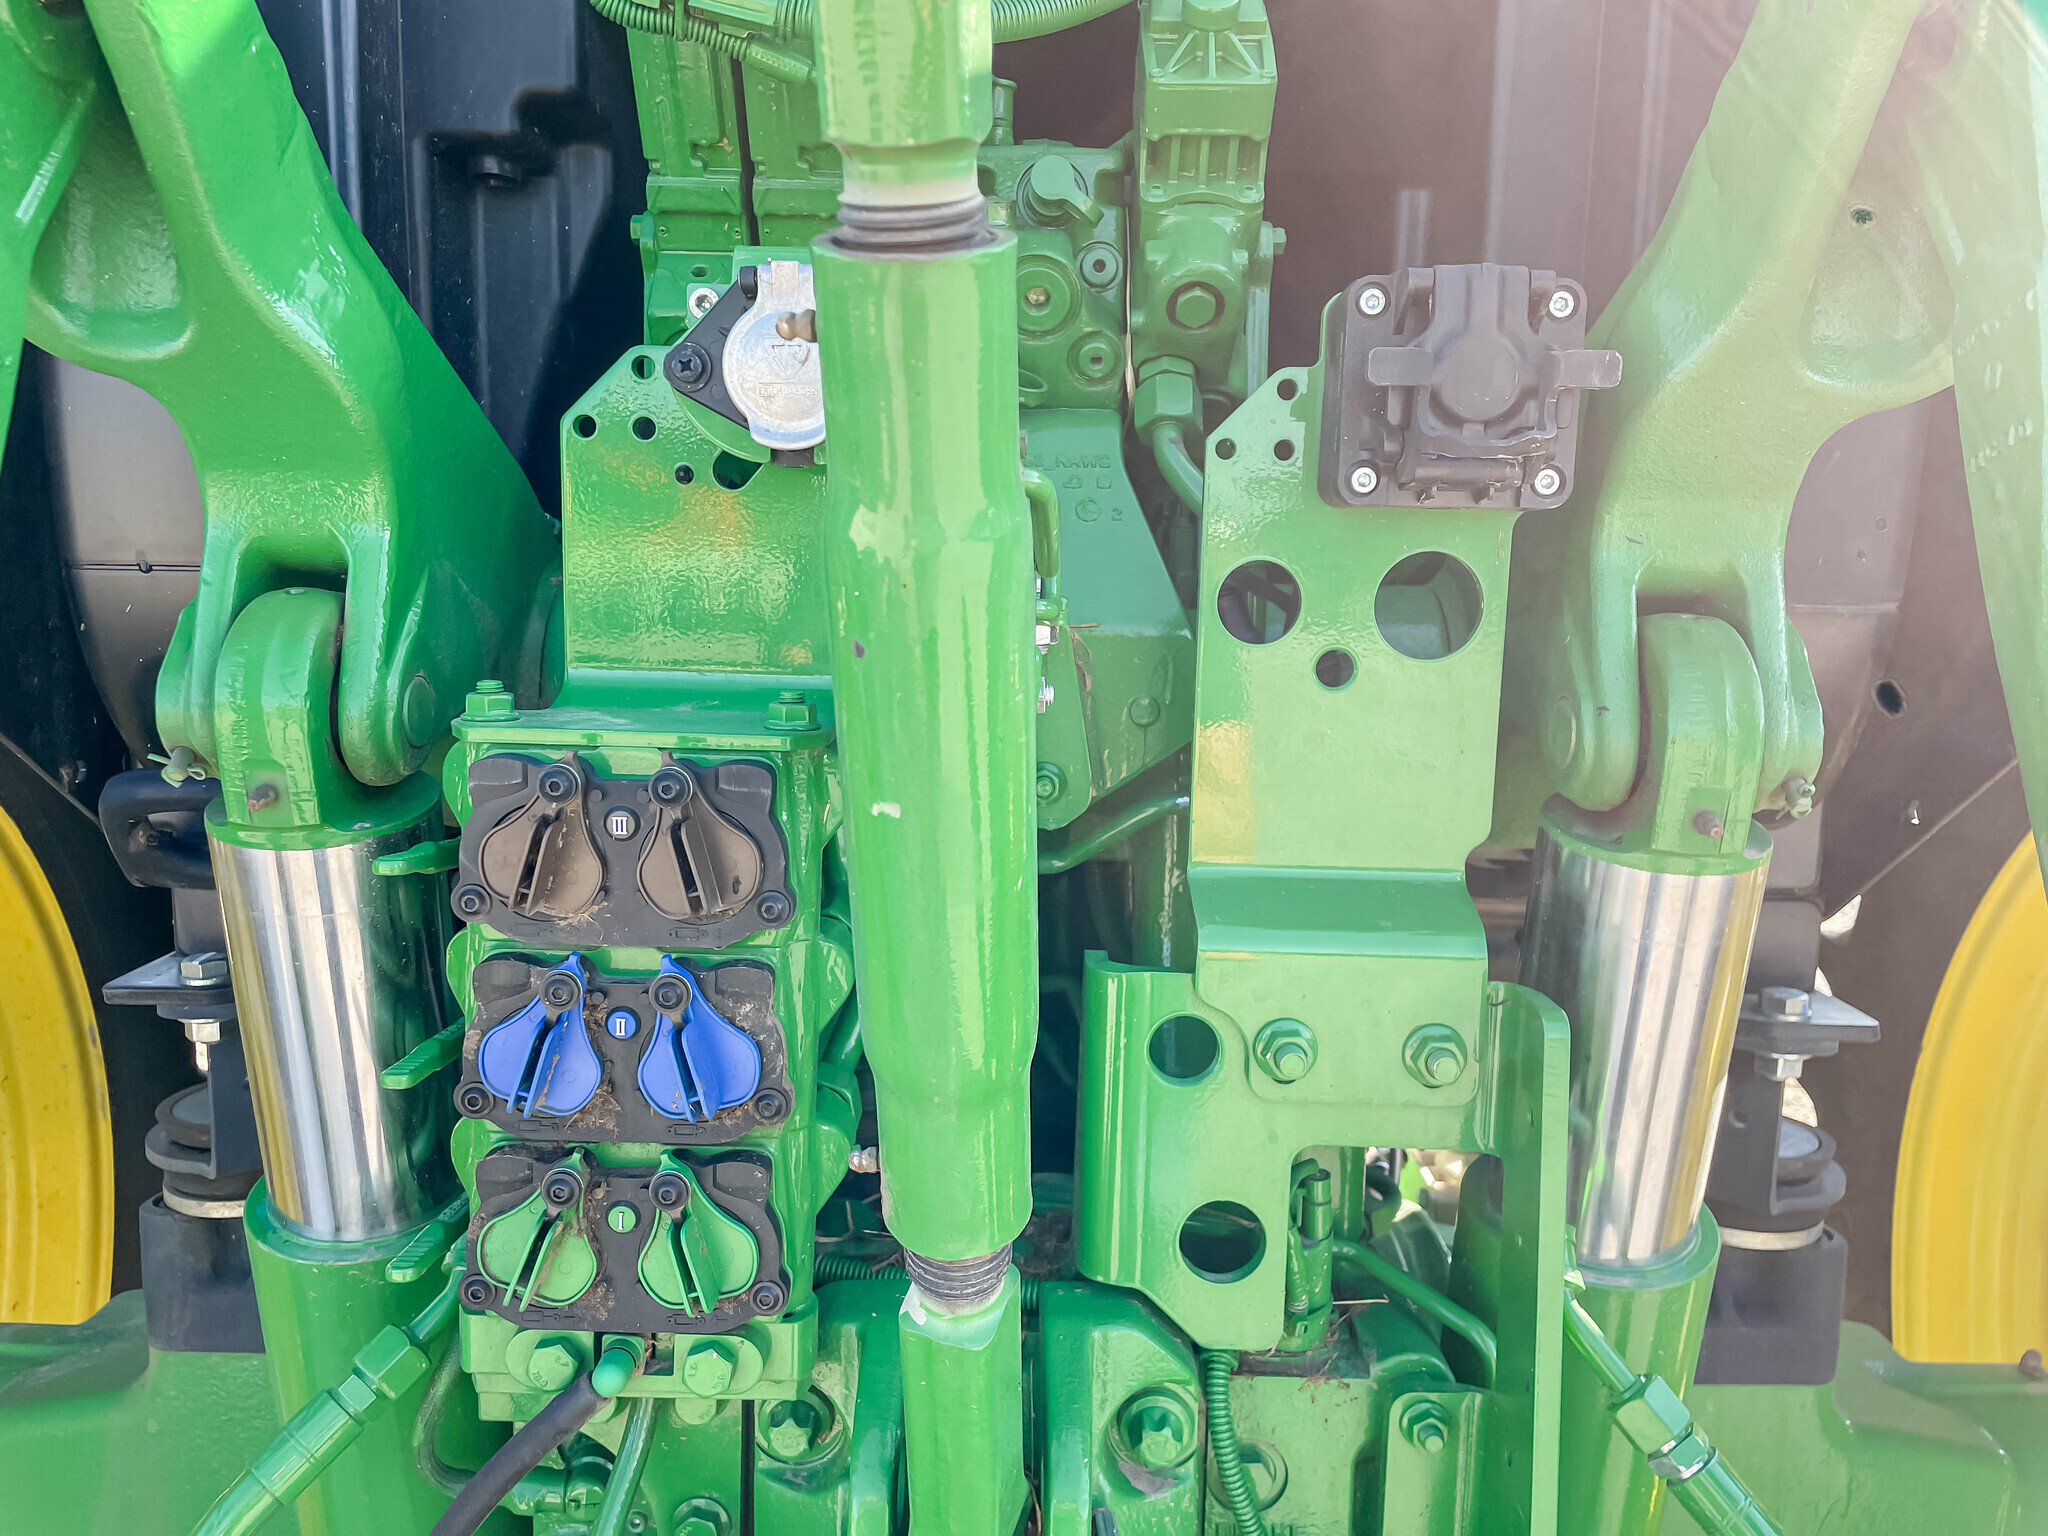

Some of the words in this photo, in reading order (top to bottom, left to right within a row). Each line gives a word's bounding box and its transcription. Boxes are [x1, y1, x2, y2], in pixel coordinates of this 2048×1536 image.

[758, 386, 783, 396] ERICH
[611, 816, 628, 835] III
[615, 1018, 626, 1036] II
